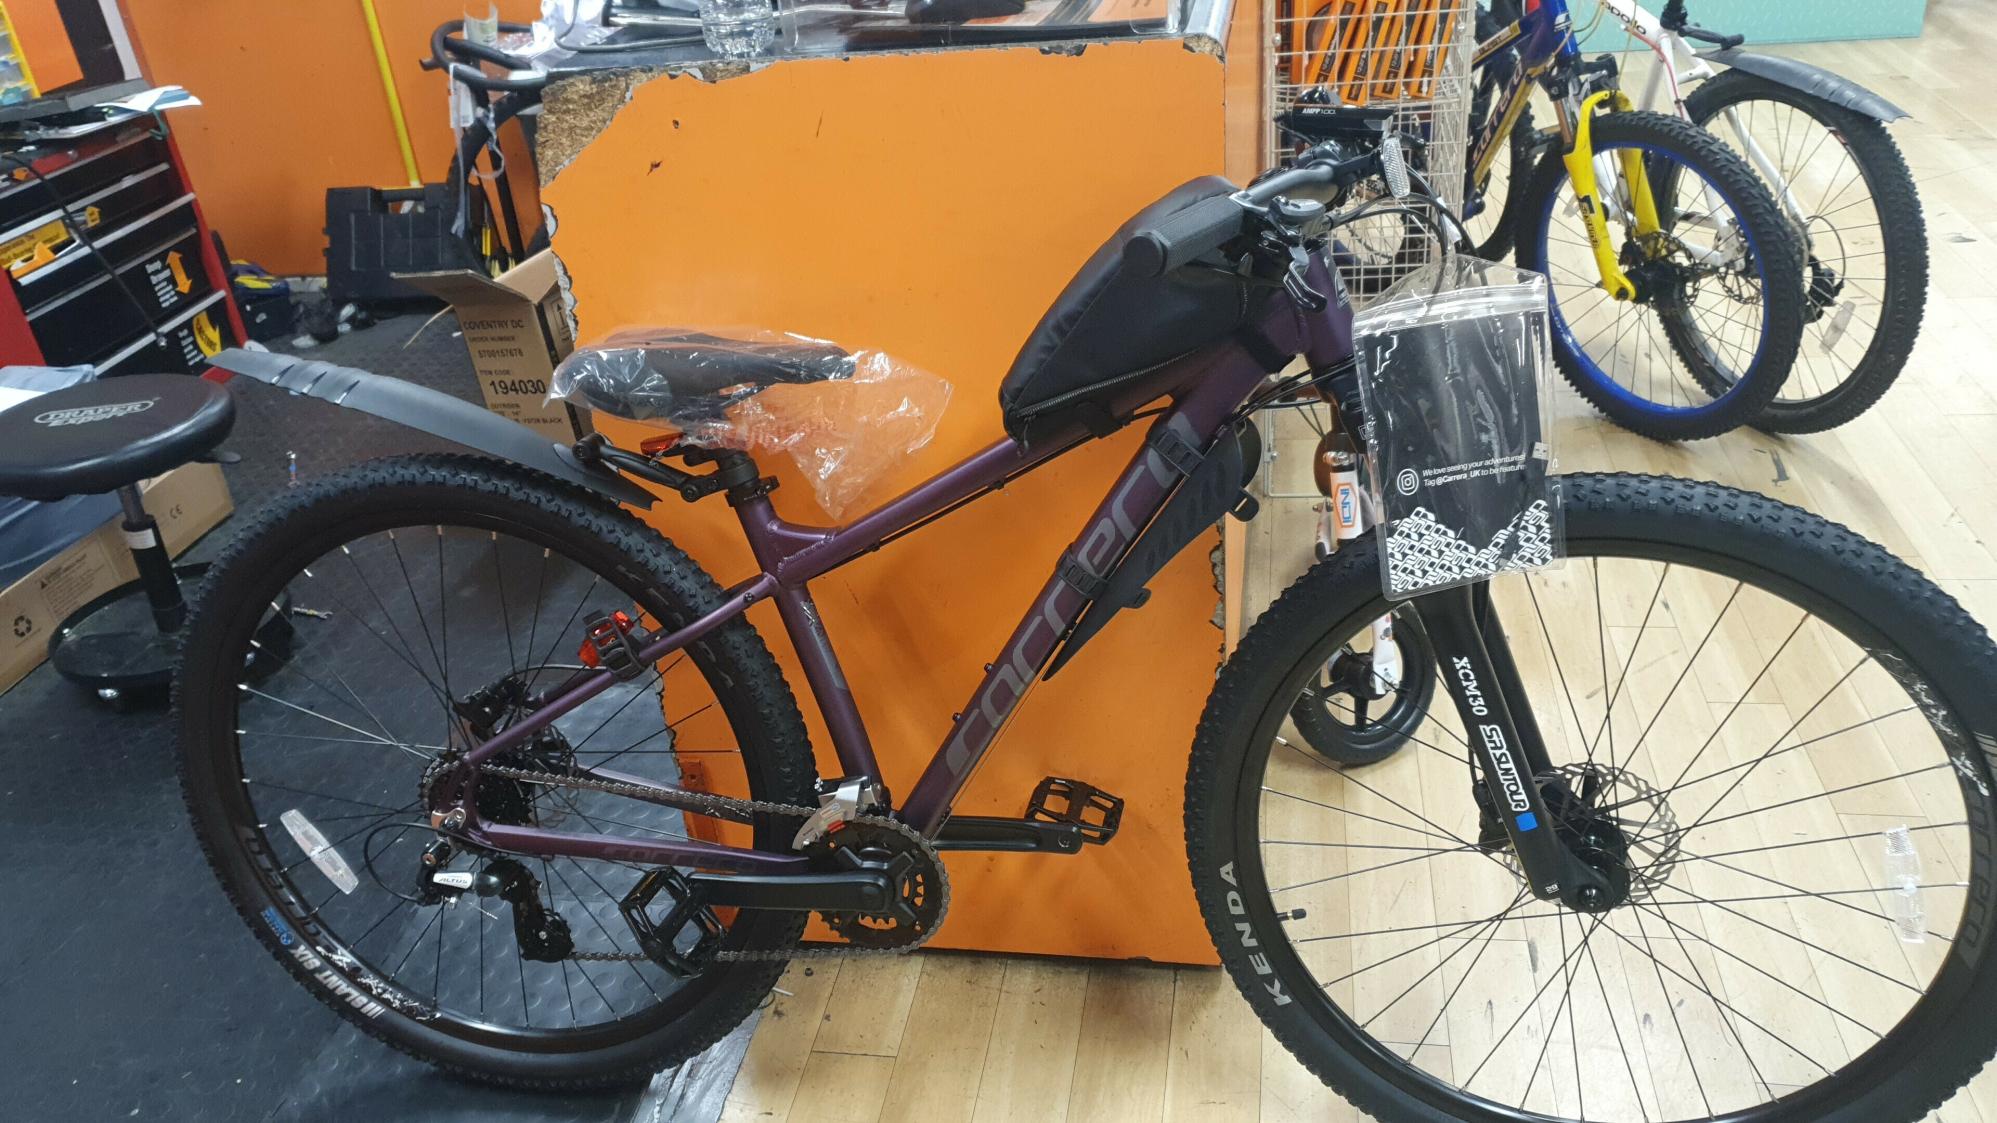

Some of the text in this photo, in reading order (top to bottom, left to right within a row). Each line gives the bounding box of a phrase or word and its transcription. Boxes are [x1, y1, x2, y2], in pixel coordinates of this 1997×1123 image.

[463, 320, 510, 331] COVENTRY
[489, 379, 547, 395] 194030
[1424, 478, 1436, 487] Tag
[1453, 656, 1488, 717] XCM30
[1491, 749, 1530, 812] SUNTOUR
[1219, 861, 1292, 1007] KENDA
[289, 944, 369, 1009] SLANT SIX
